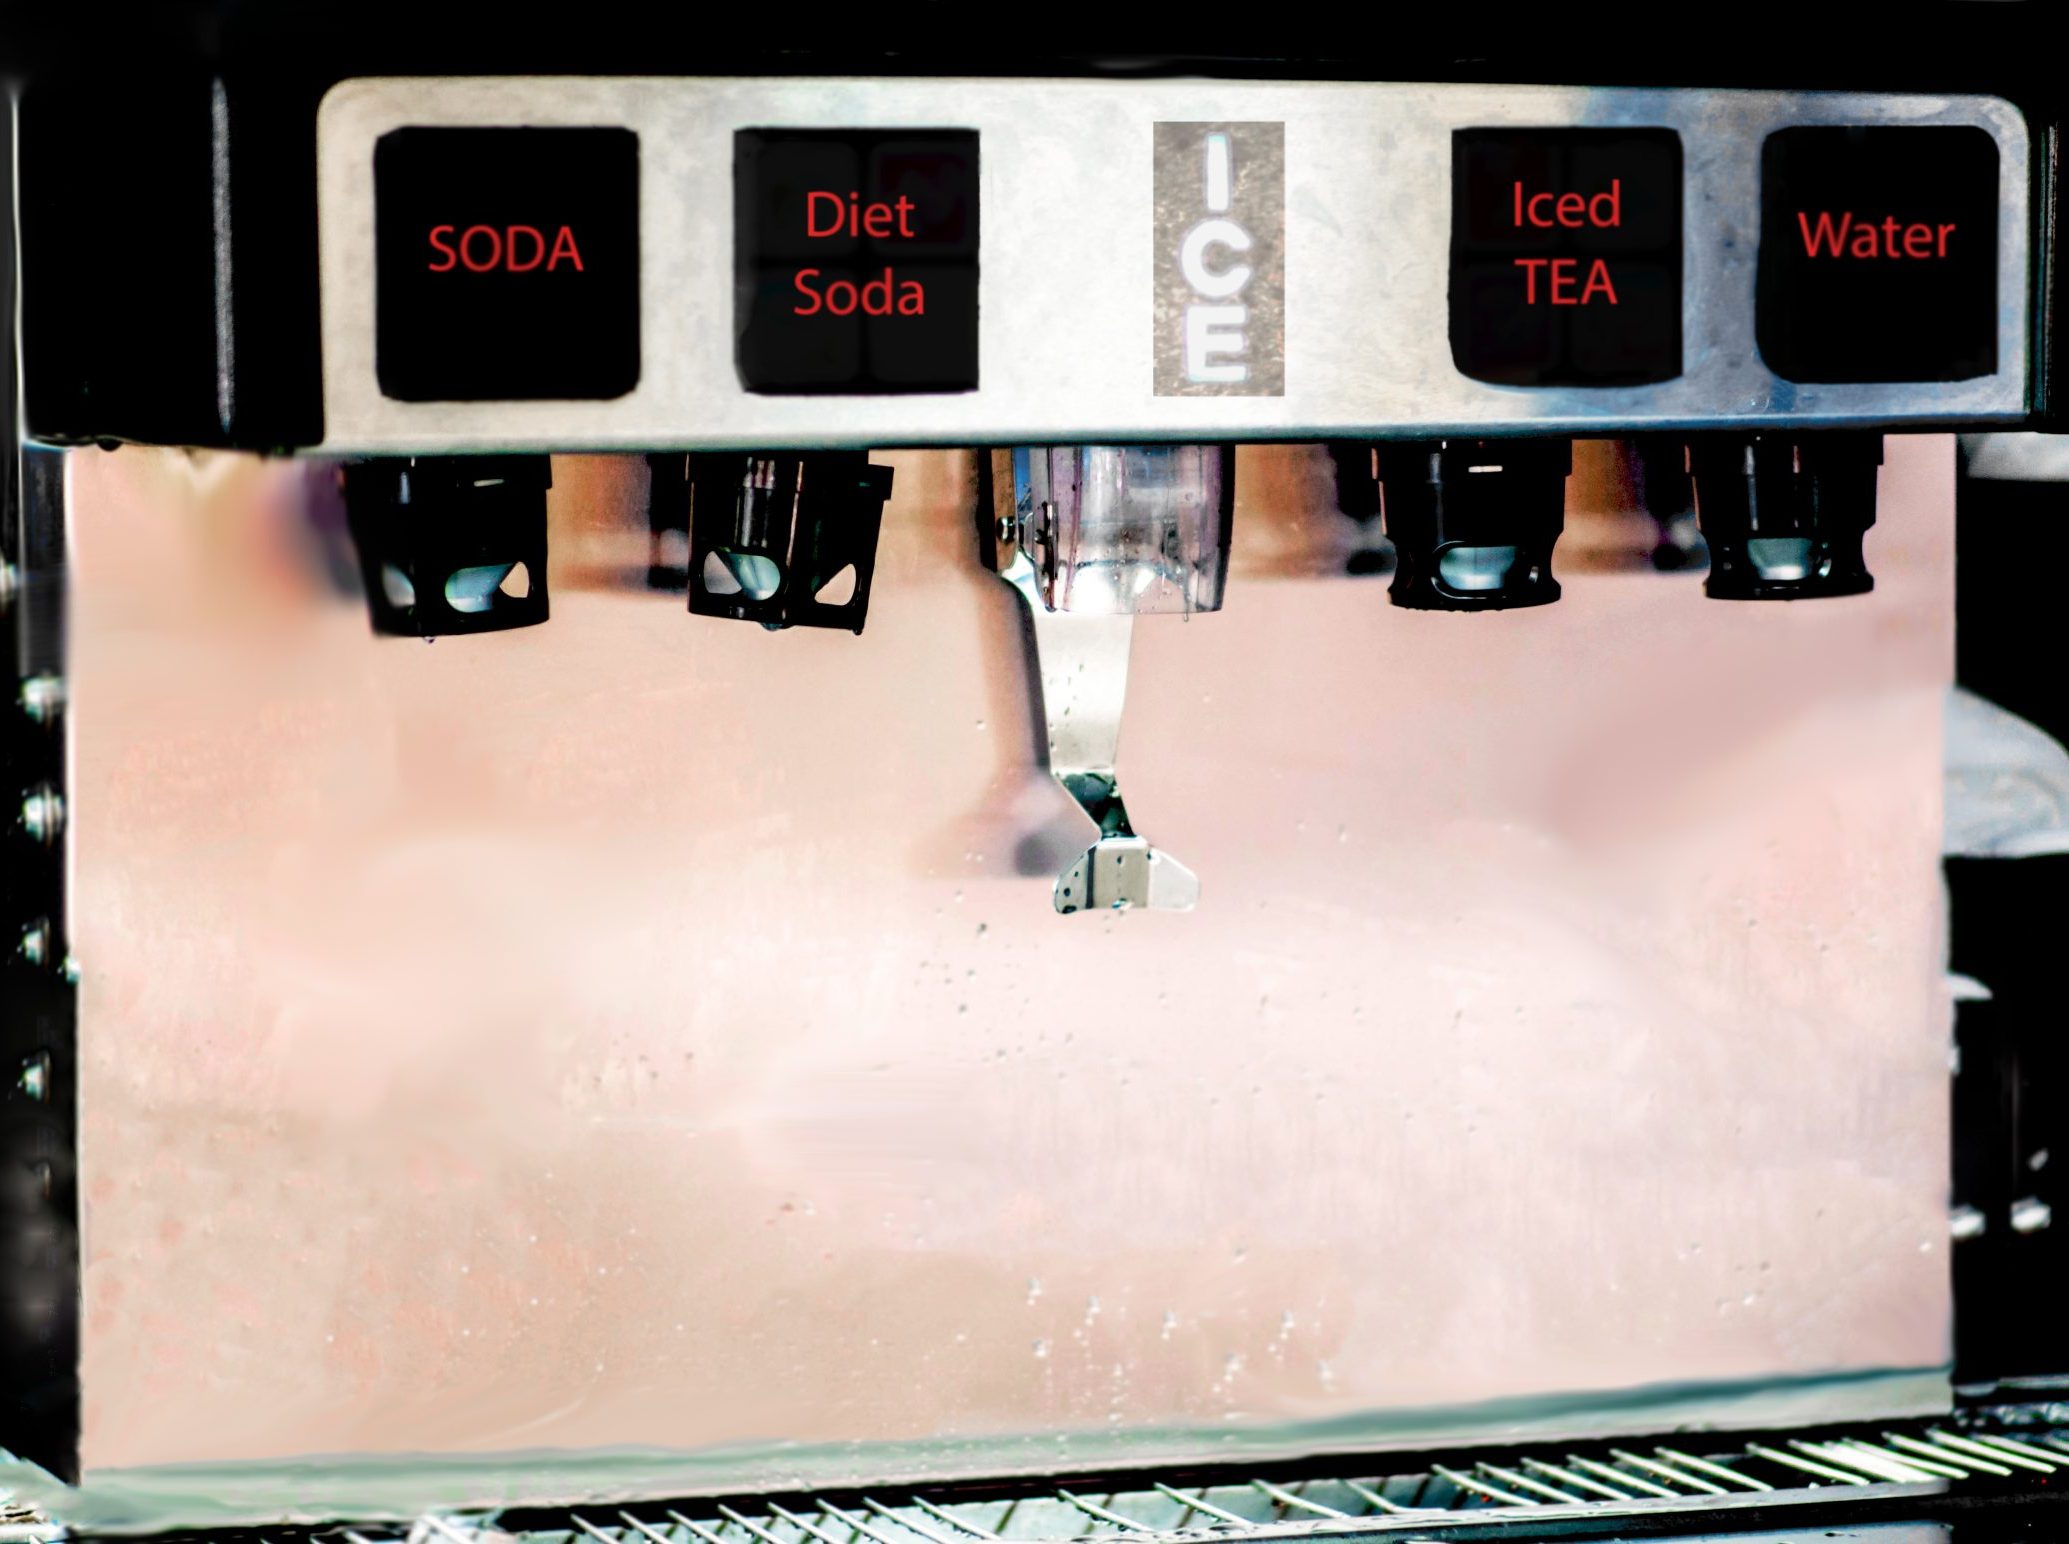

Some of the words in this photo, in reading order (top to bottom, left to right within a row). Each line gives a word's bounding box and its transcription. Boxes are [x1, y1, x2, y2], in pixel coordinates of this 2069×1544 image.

[806, 190, 916, 239] Diet
[1513, 178, 1621, 229] Iced
[428, 224, 584, 273] SODA
[1180, 132, 1252, 383] ICE
[1797, 211, 1957, 259] Water
[793, 266, 925, 317] Soda
[1514, 258, 1618, 305] TEA
